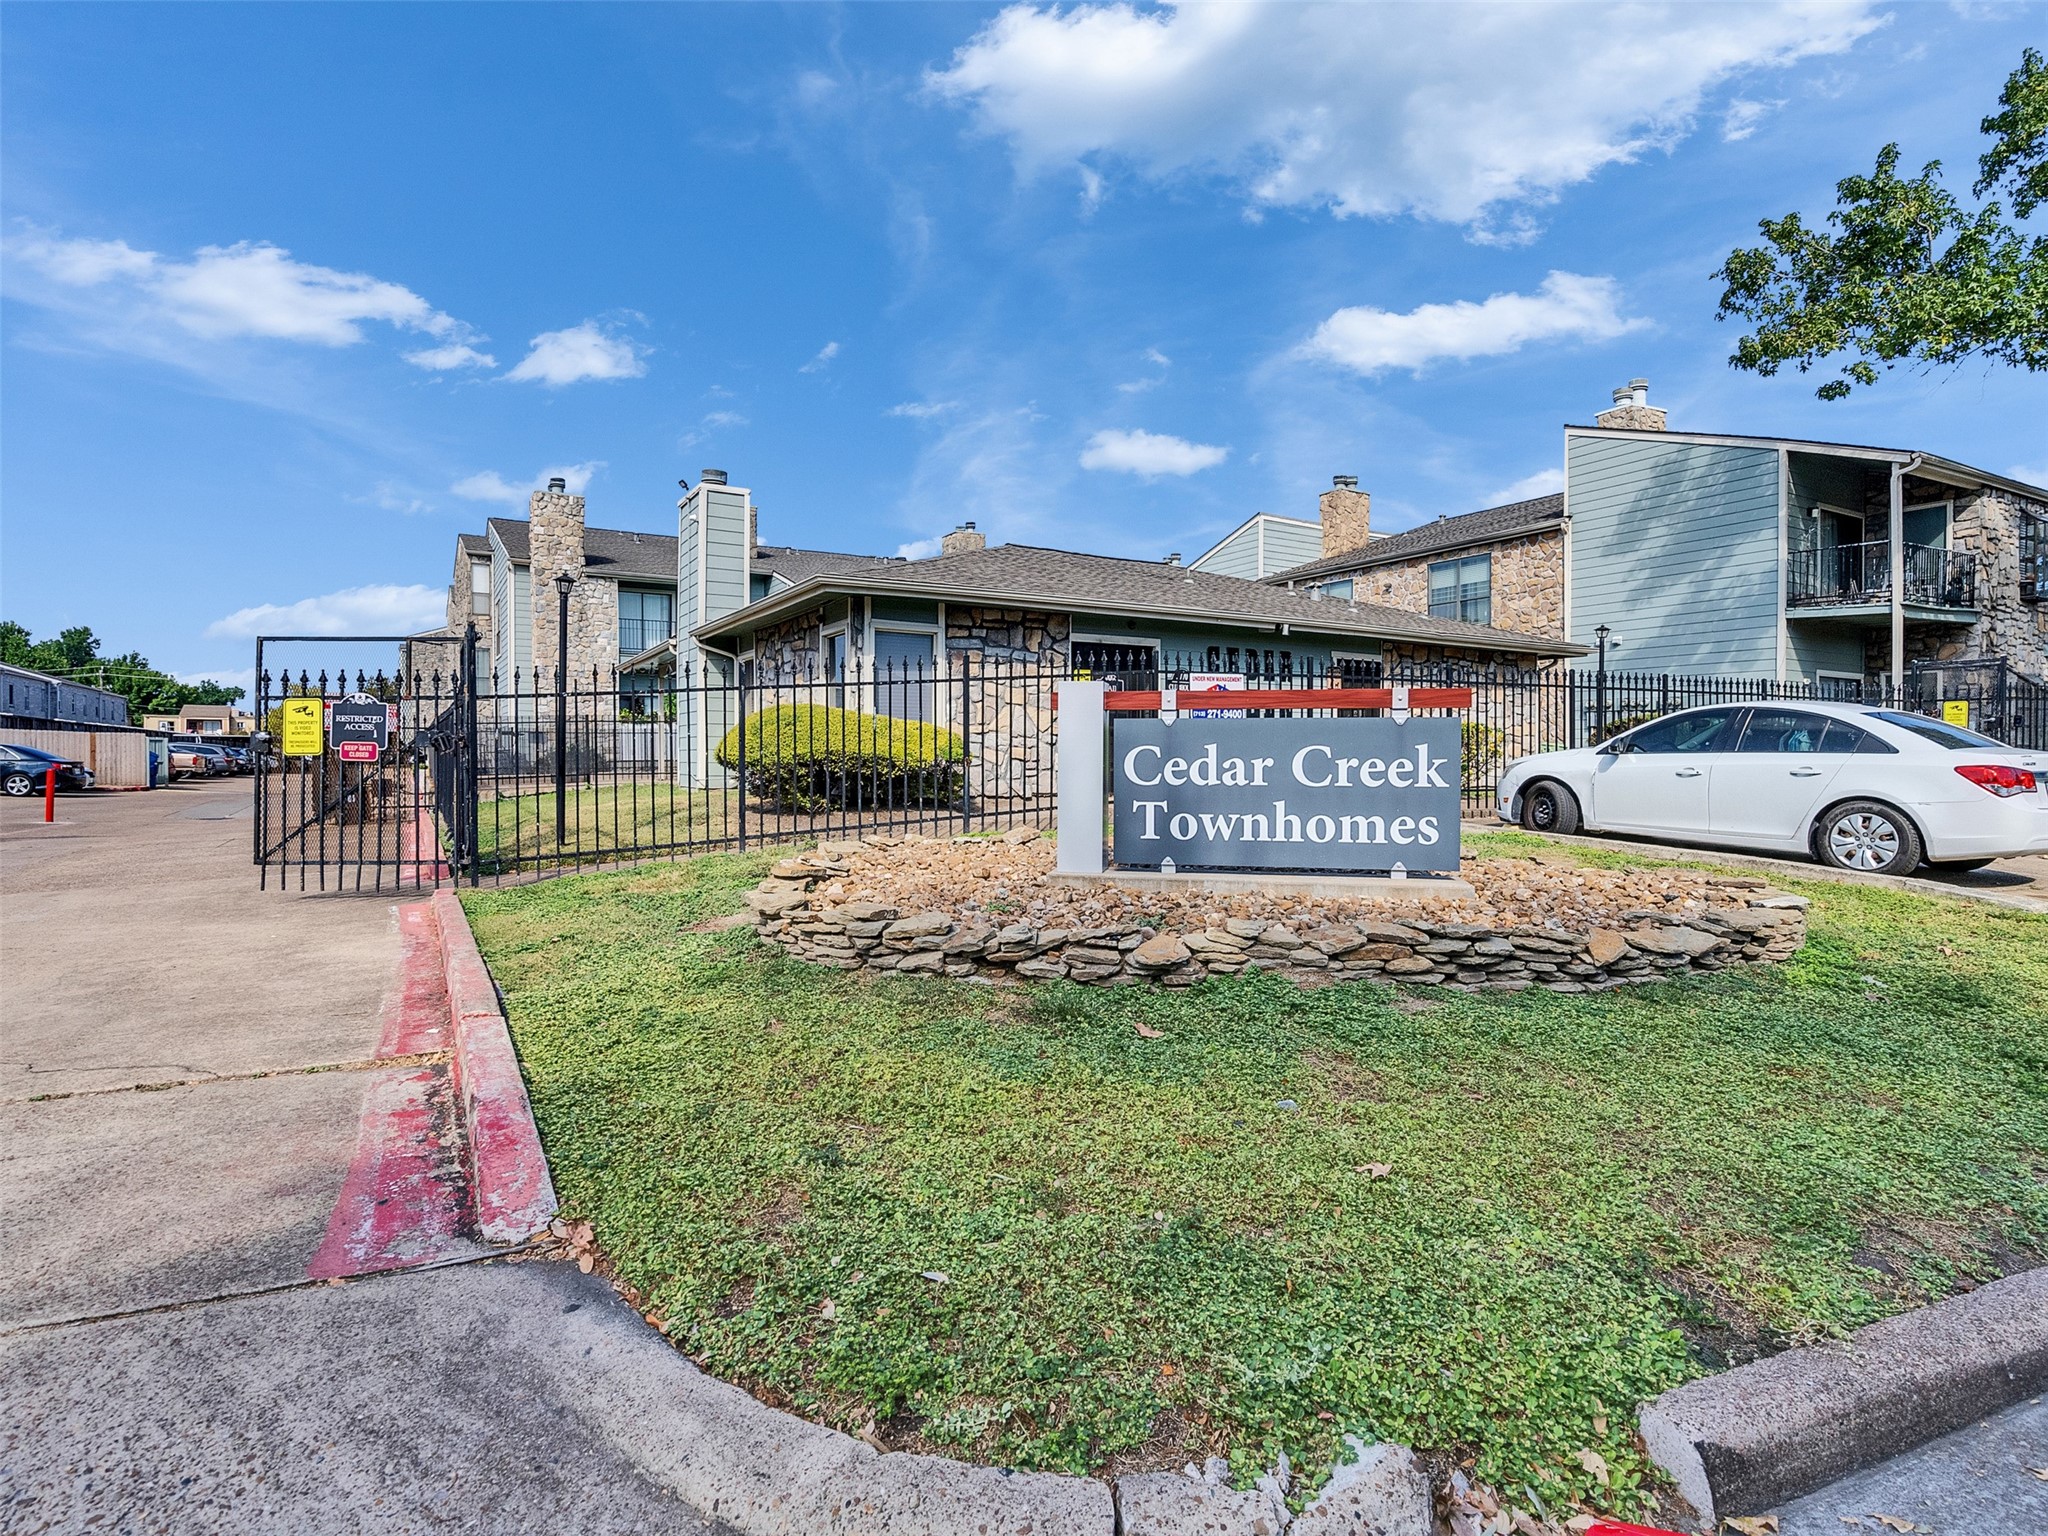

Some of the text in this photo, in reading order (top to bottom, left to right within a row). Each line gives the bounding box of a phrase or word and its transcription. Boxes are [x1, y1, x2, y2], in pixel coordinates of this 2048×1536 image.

[335, 715, 384, 723] RESTRICTED
[1207, 709, 1242, 718] 271-9400
[1123, 743, 1450, 788] Cedar Creek
[1132, 800, 1440, 845] Townhomes
